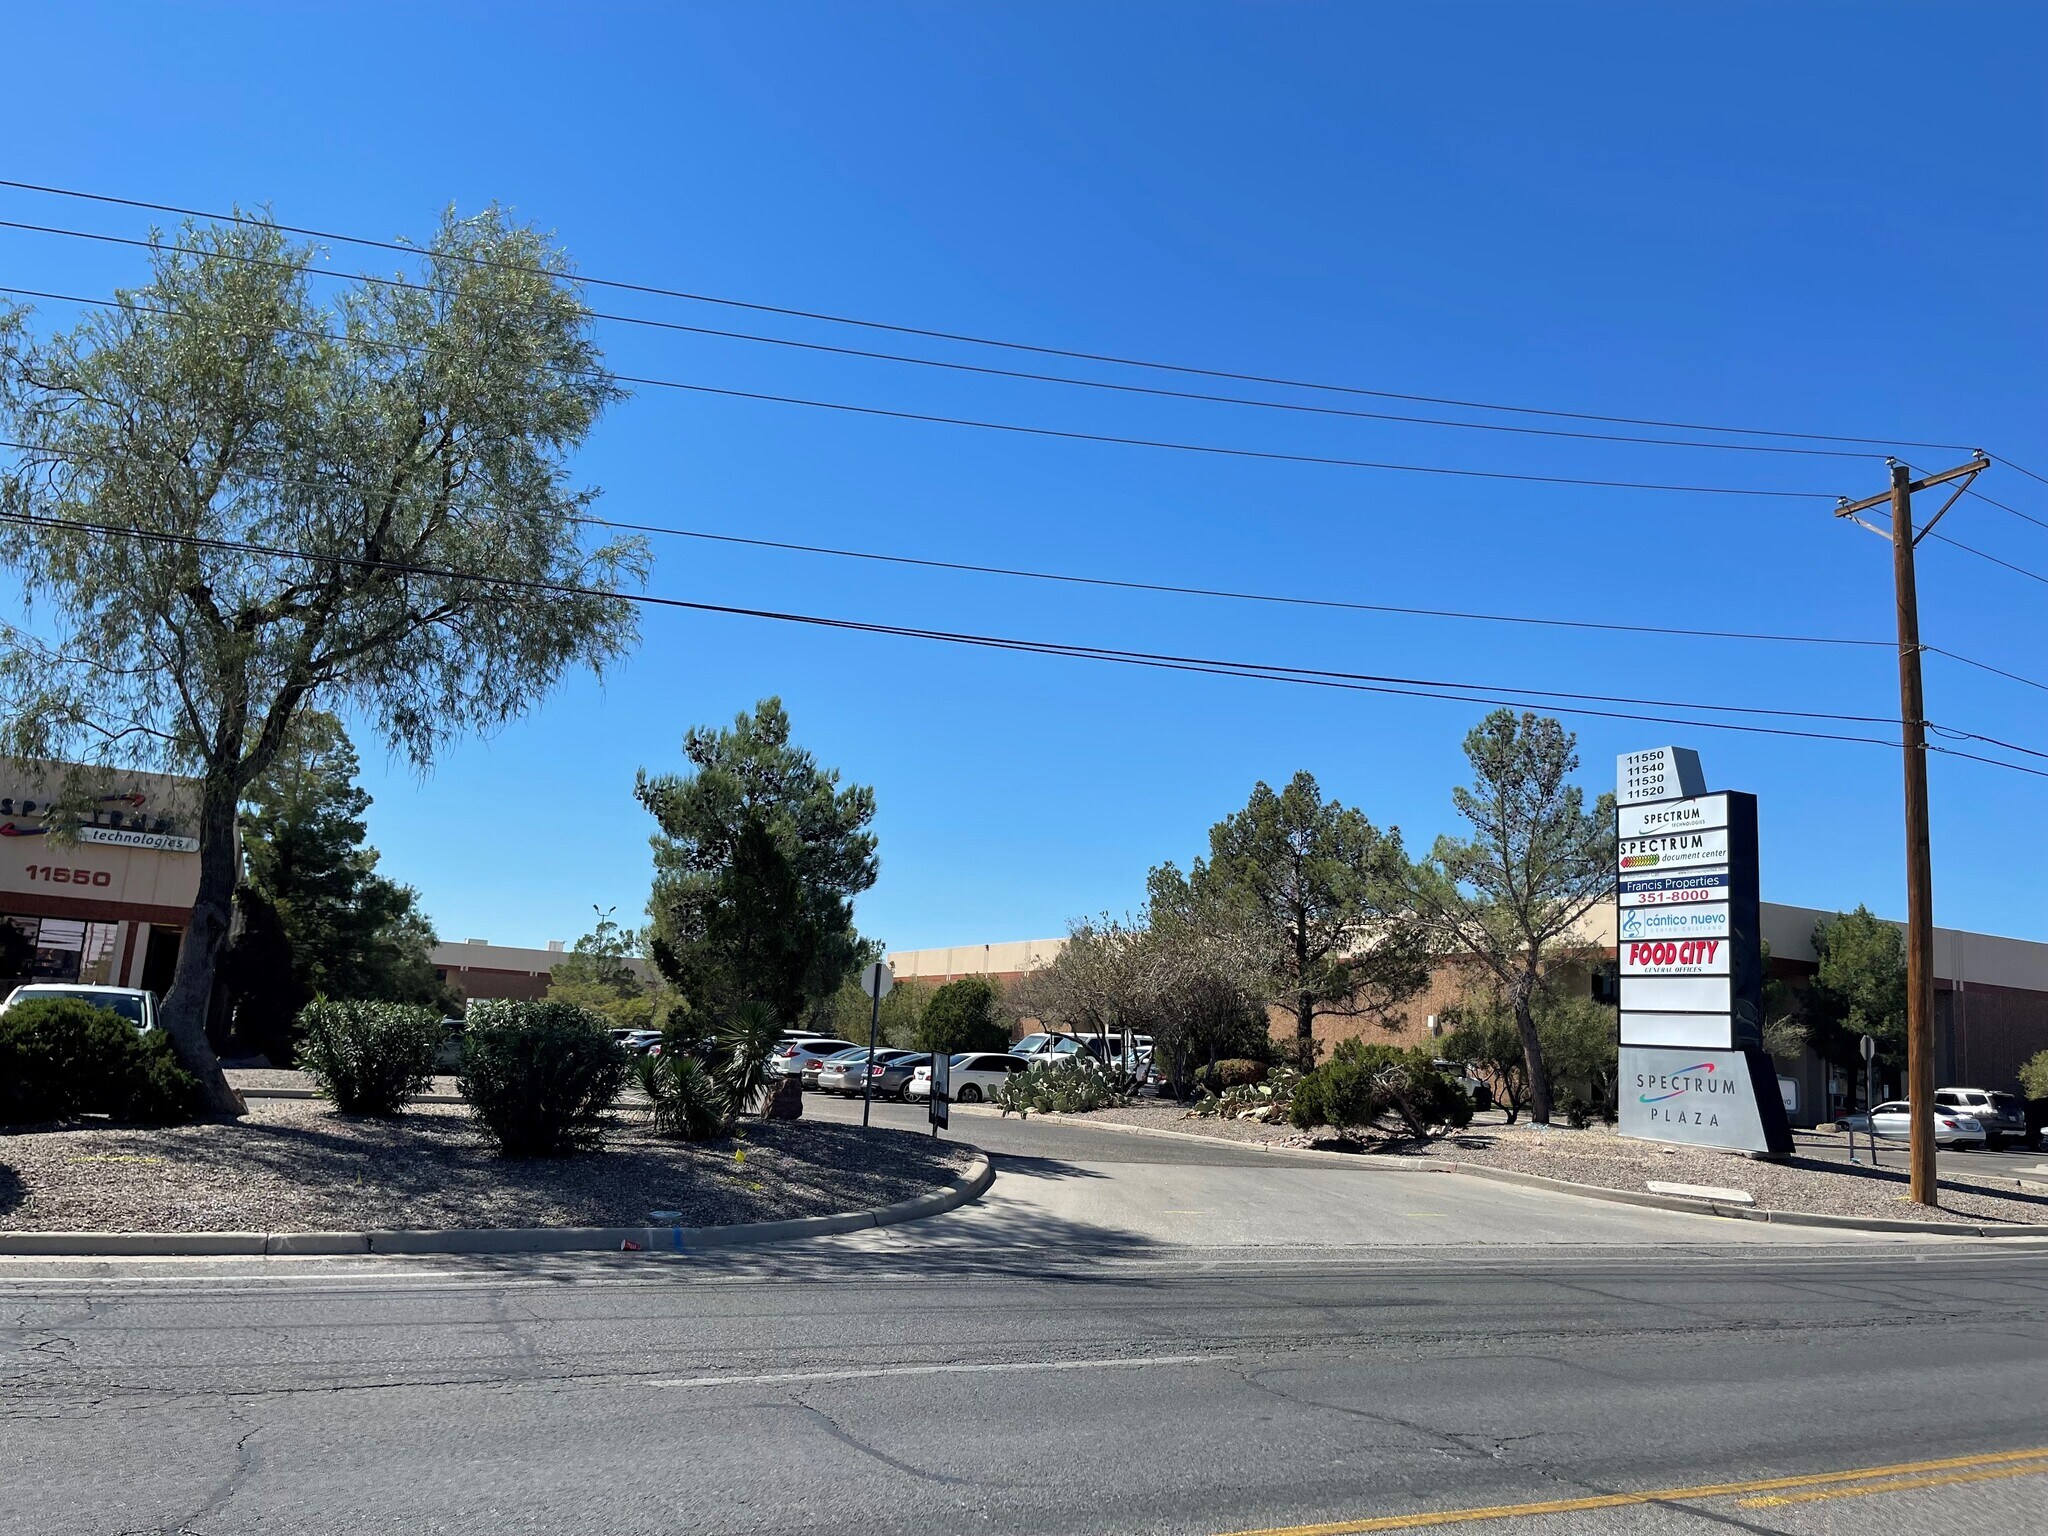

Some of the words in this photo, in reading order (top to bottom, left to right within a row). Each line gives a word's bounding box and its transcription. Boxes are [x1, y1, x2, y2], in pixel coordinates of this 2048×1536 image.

[1627, 751, 1664, 764] 11550
[1627, 762, 1664, 776] 11540
[1627, 774, 1664, 787] 11530
[1627, 786, 1664, 798] 11520
[1644, 808, 1700, 825] SPECTRUM
[92, 830, 183, 849] technologies
[1620, 834, 1703, 855] SPECTRUM
[1661, 852, 1700, 862] document
[1701, 849, 1727, 858] center
[25, 865, 111, 887] 11550
[1627, 880, 1662, 892] Francis
[1665, 876, 1720, 890] Properties
[1638, 889, 1709, 903] 351-8000
[1646, 914, 1687, 927] cántico
[1690, 913, 1726, 925] nuevo
[1629, 942, 1678, 966] FOOD
[1679, 940, 1720, 965] CITY
[1637, 1073, 1736, 1095] SPECTRUM
[1651, 1107, 1720, 1127] PLAZA
